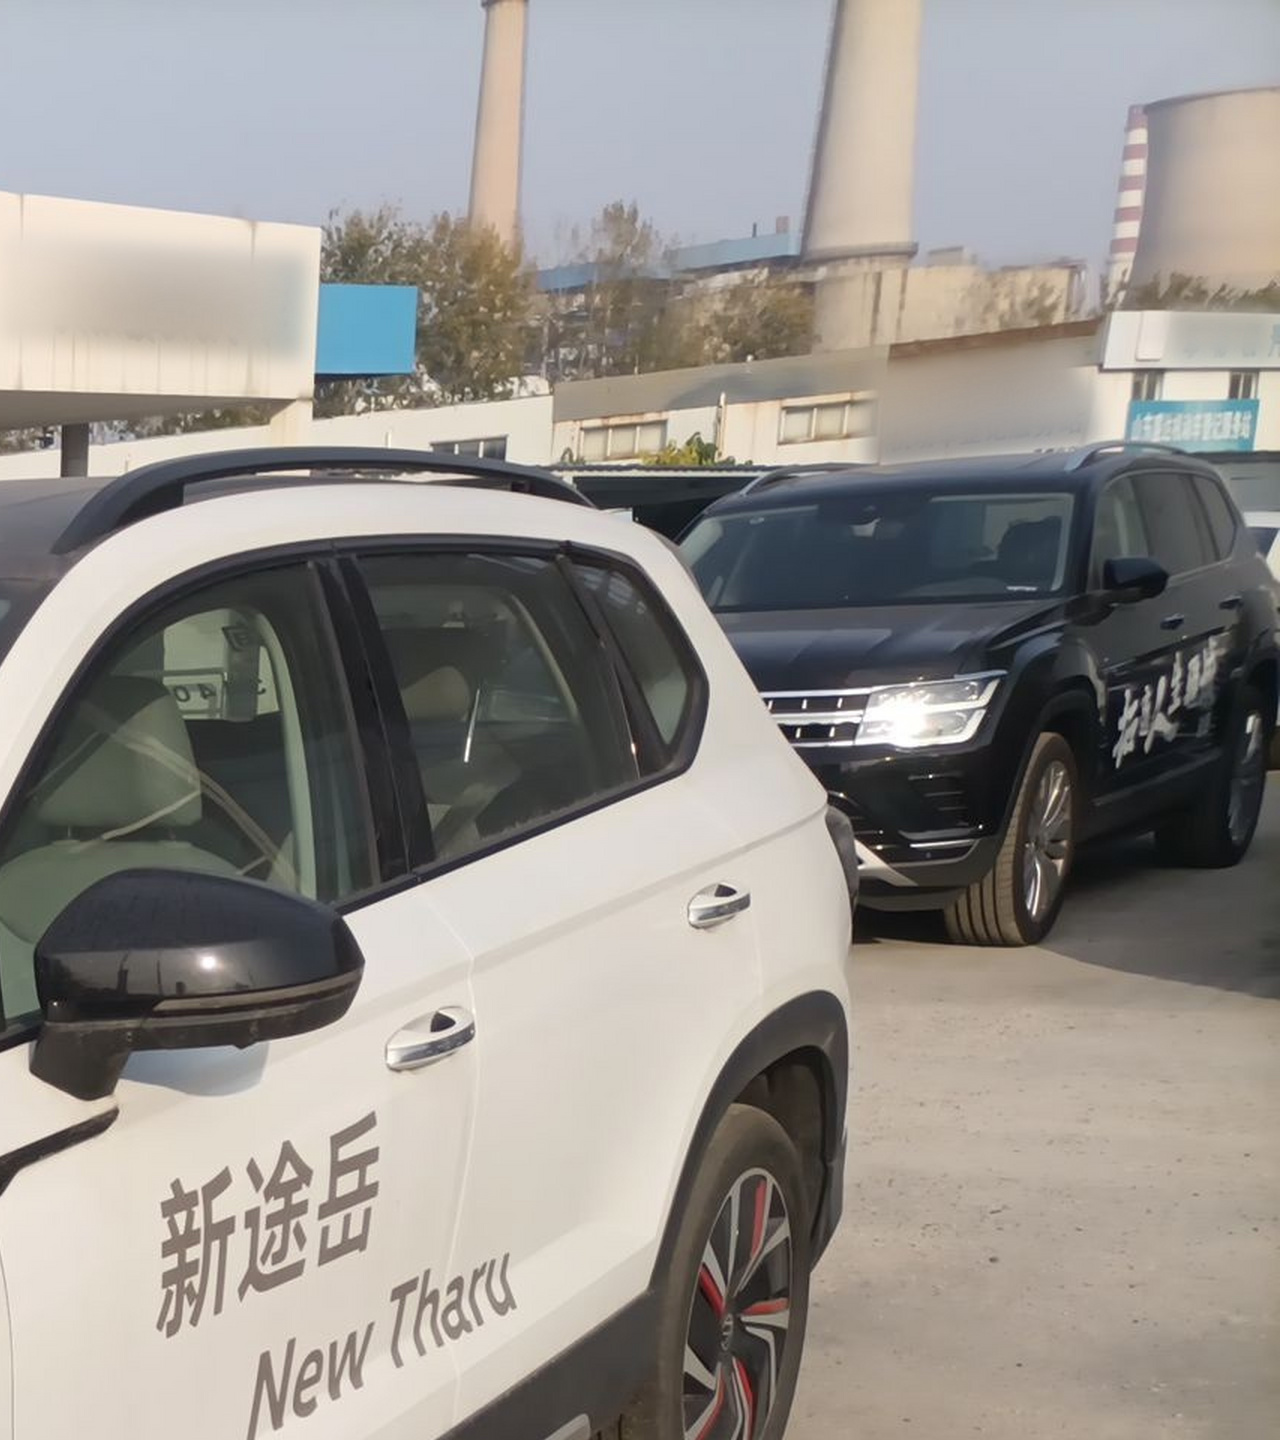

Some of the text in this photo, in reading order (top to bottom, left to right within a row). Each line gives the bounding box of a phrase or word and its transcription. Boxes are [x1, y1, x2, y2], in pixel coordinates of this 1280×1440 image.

[156, 1110, 380, 1339] 新途岳
[389, 1252, 518, 1369] Tharu
